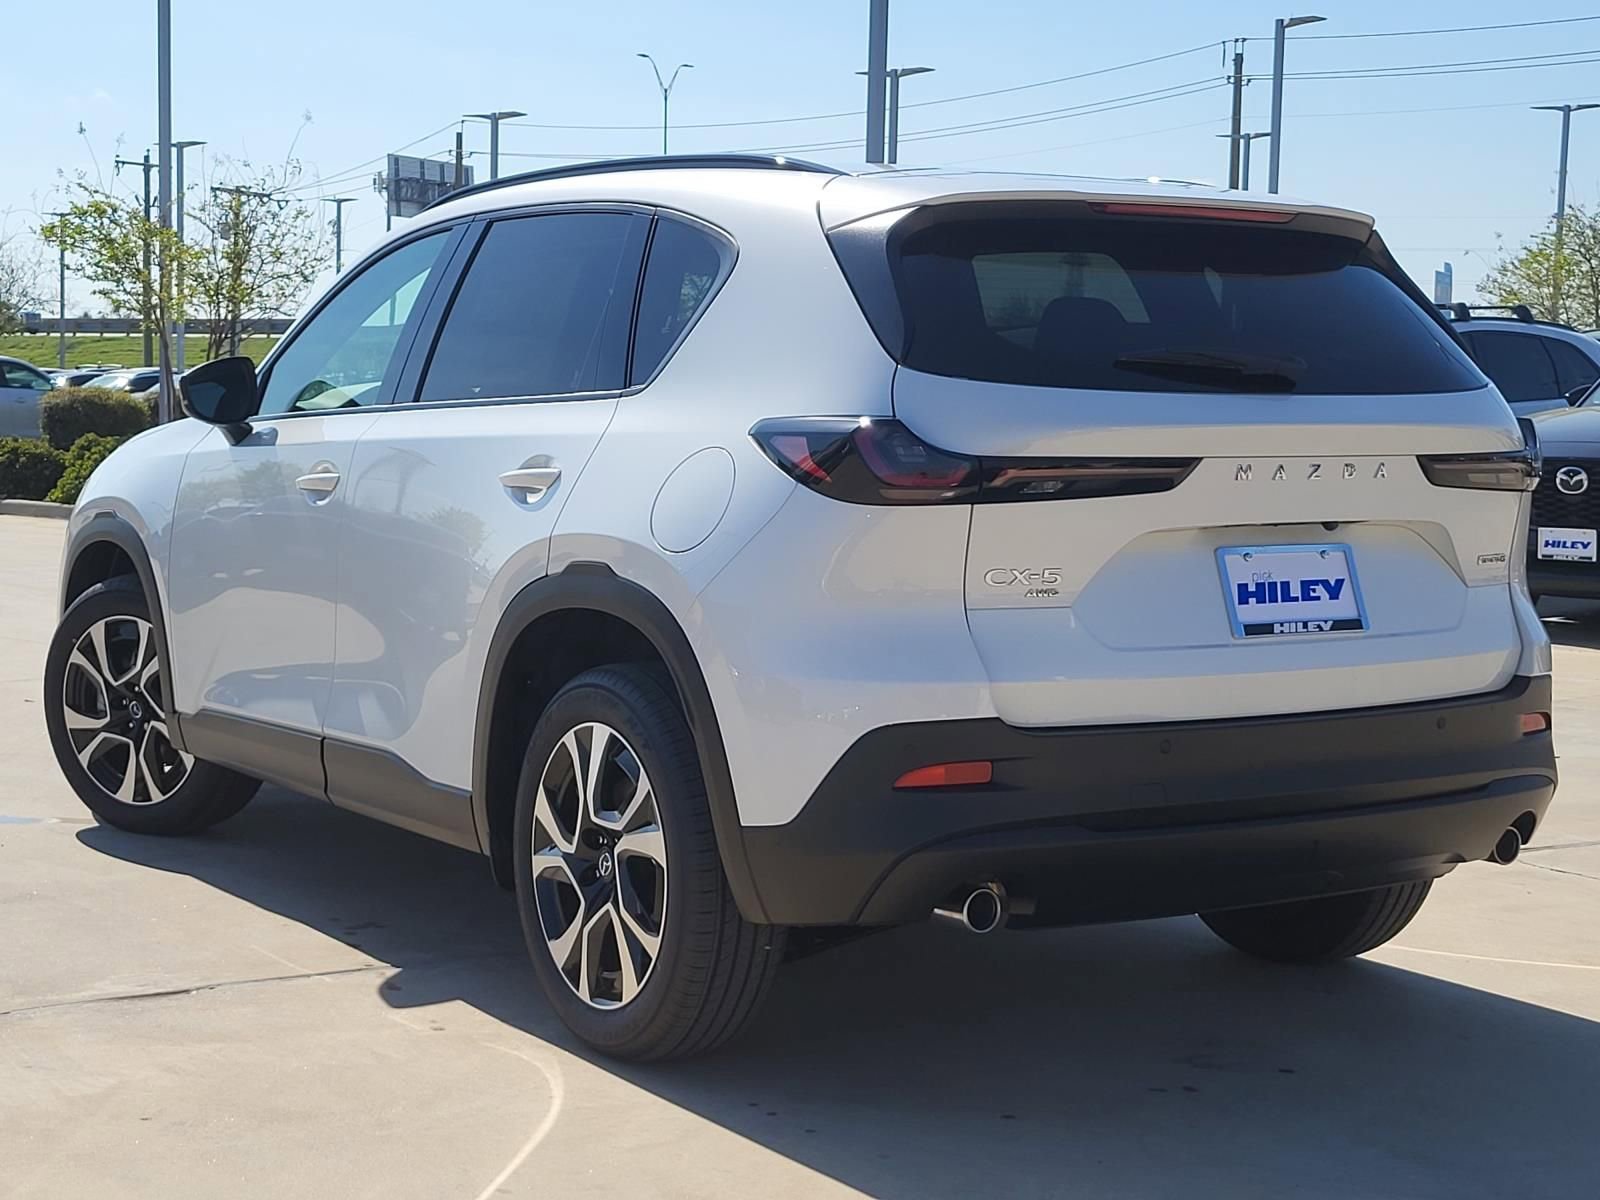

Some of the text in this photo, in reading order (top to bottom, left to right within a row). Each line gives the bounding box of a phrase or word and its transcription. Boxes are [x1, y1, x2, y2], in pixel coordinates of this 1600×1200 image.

[1234, 462, 1388, 481] MAZDA
[1544, 539, 1592, 550] HILEY
[983, 567, 1063, 587] CX-5
[1024, 588, 1060, 598] AWD
[1236, 578, 1346, 606] HILEY
[1273, 620, 1334, 634] HILEY
